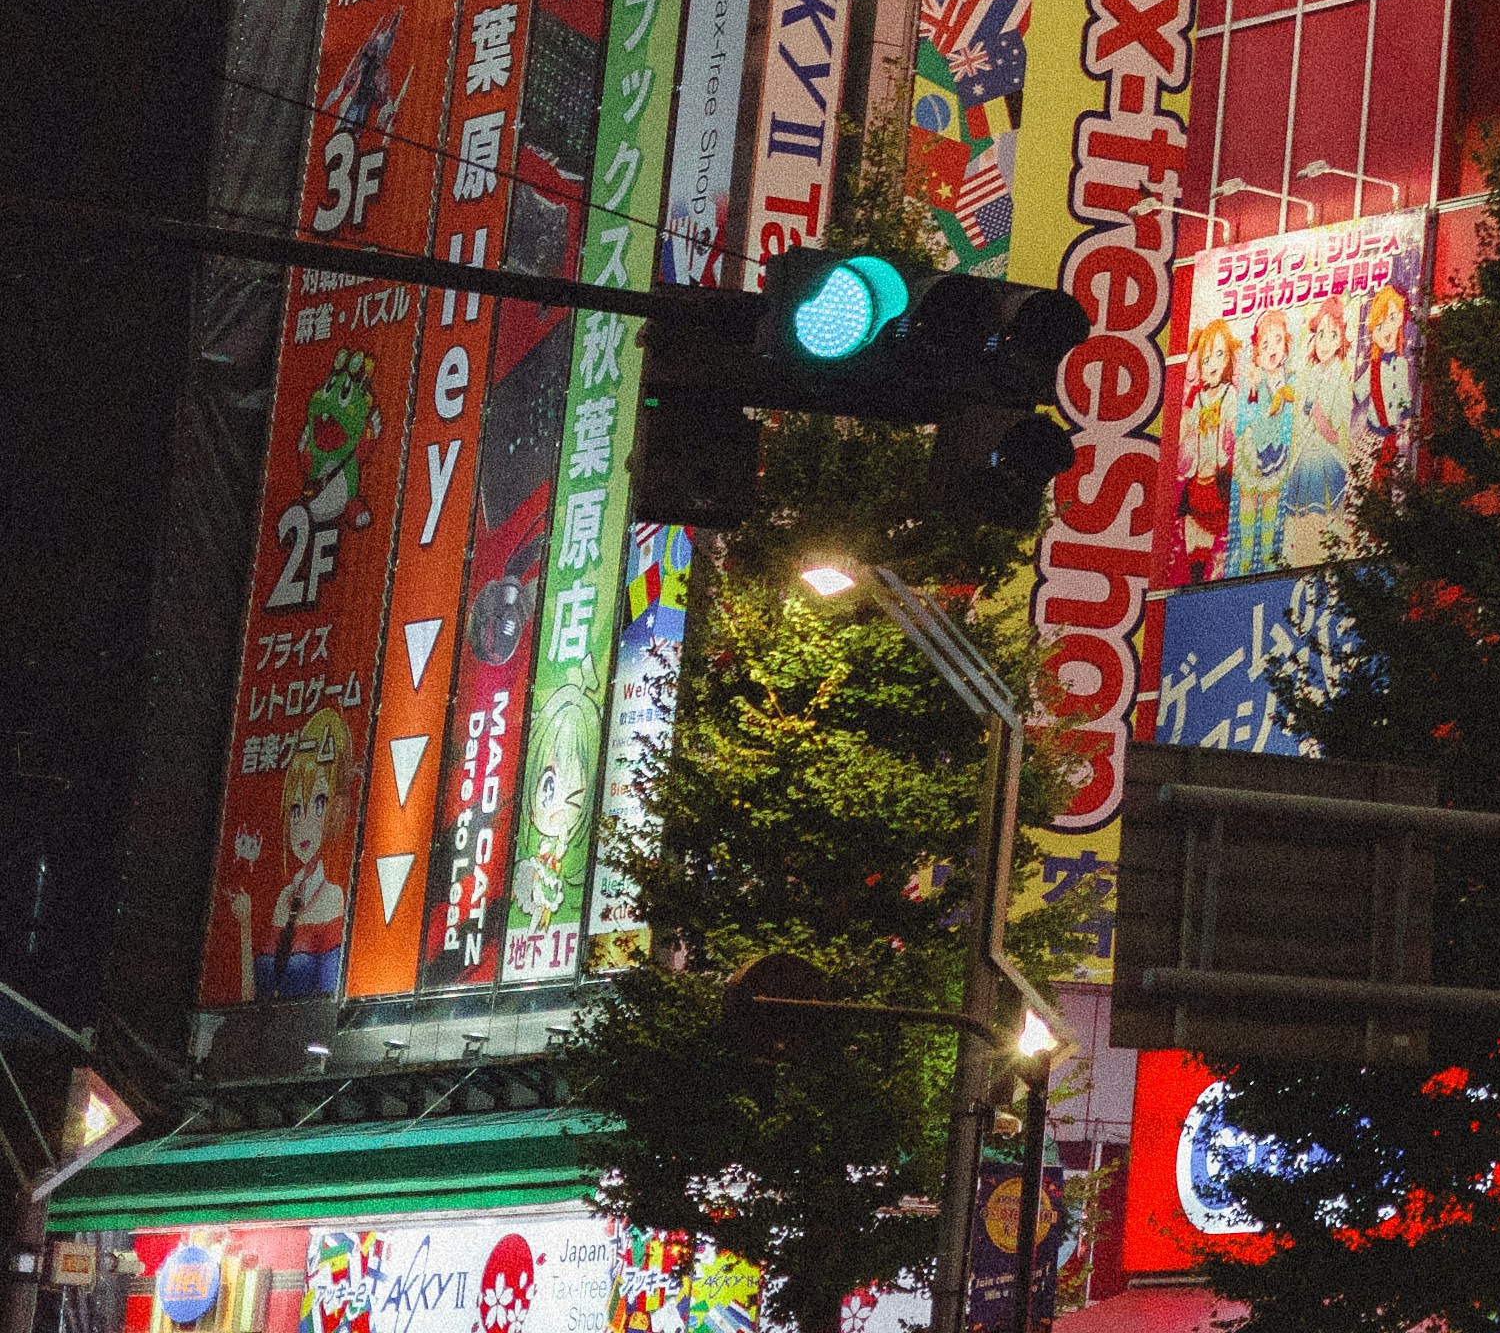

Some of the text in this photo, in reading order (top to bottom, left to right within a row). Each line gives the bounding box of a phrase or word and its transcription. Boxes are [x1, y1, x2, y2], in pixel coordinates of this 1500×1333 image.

[312, 131, 383, 233] 3F
[690, 131, 719, 216] Shop
[1220, 259, 1392, 317] コラボカフェ展開中
[548, 309, 624, 664] 秋葉原店
[263, 504, 340, 611] 2F
[257, 624, 330, 671] プライズ
[248, 674, 361, 722] レトロゲーム
[241, 726, 335, 775] 音楽ゲーム
[443, 713, 485, 952] Dare to Lead
[464, 690, 509, 966] MAD CATZ
[551, 1275, 608, 1299] Tax-free
